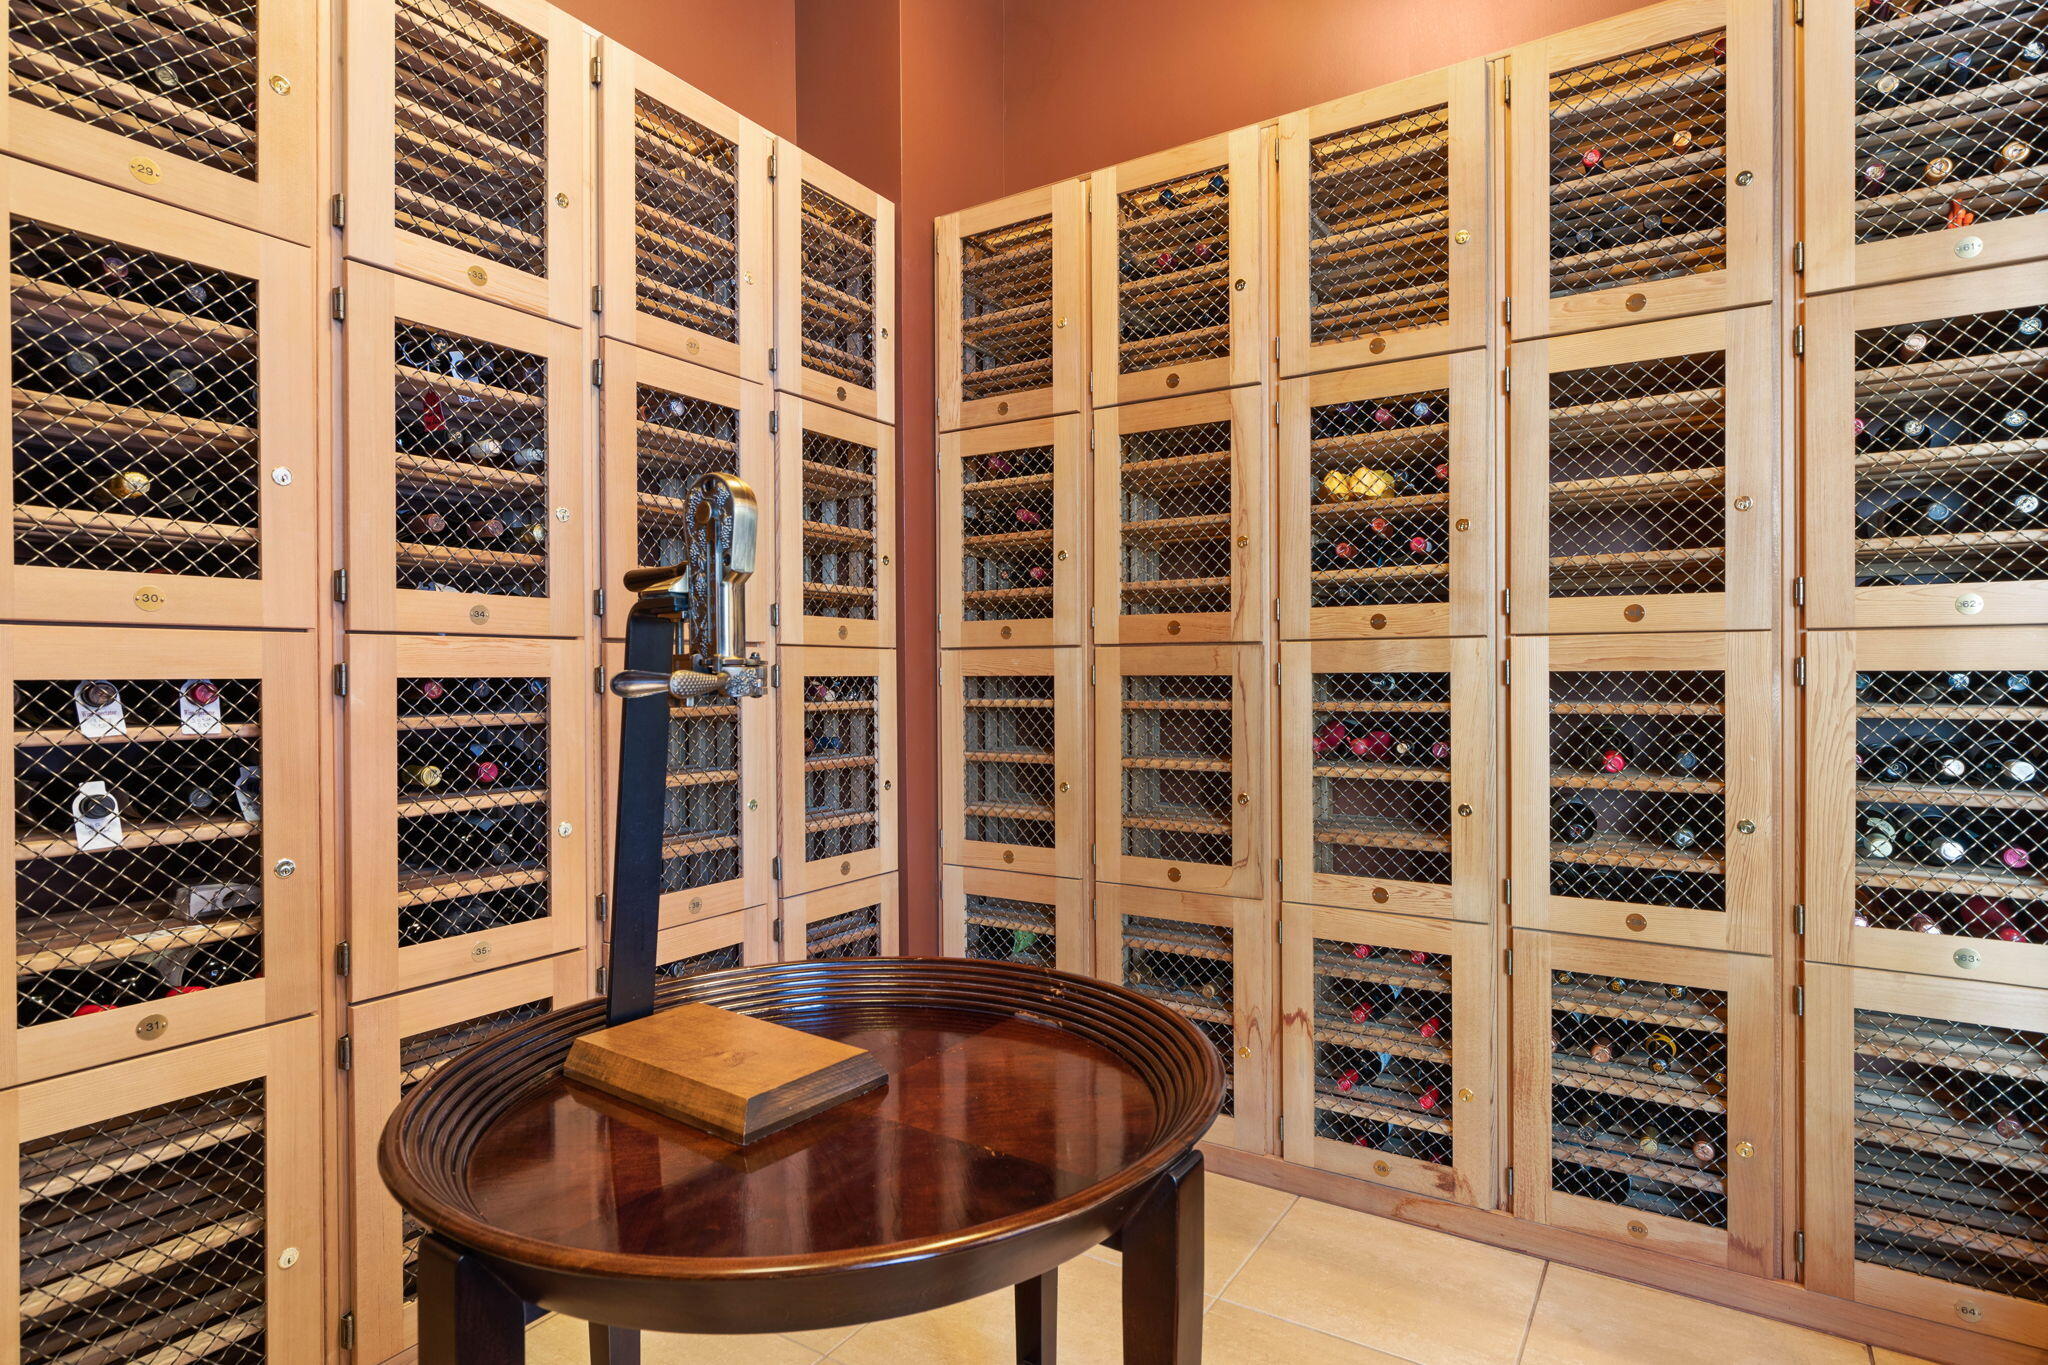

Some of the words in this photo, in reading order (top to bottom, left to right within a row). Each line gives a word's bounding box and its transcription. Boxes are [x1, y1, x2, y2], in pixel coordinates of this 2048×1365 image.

[137, 164, 153, 176] 29
[1963, 243, 1974, 251] 61
[472, 270, 483, 280] 33
[142, 593, 159, 603] 30
[1962, 600, 1976, 608] 62
[474, 610, 485, 618] 34
[476, 947, 487, 956] 35
[1961, 954, 1975, 962] 63
[146, 1021, 159, 1032] 31
[1961, 1307, 1975, 1315] 64
